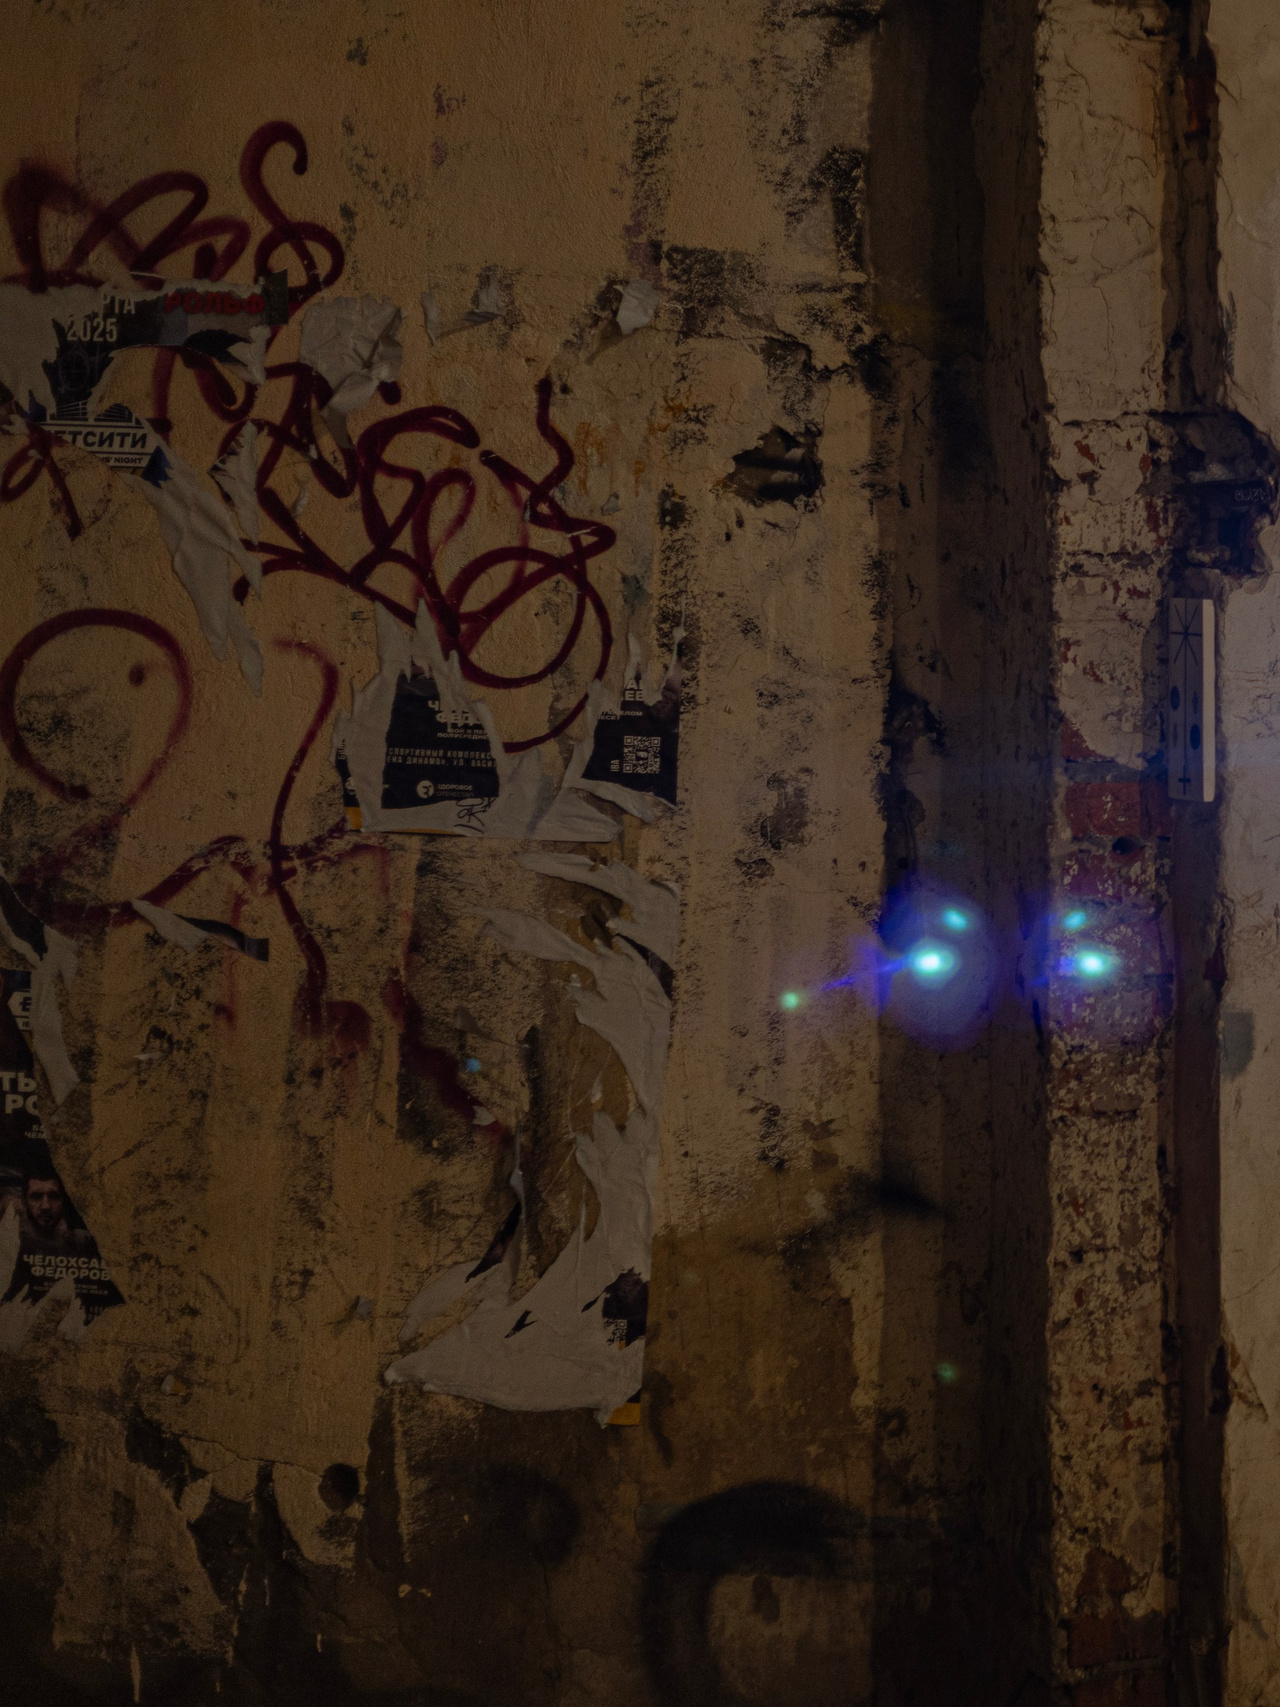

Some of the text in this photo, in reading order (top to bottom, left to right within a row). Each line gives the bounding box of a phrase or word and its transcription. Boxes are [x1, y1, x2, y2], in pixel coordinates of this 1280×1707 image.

[164, 291, 265, 314] РОЛЬФ
[66, 317, 118, 342] 2025
[113, 456, 143, 464] NIGHT
[388, 748, 492, 760] СПОРТИВНЫЙ КОМПЛЕКС
[437, 783, 473, 791] ЗДОРОВОЕ
[31, 1265, 110, 1281] ФЕДОРОВ
